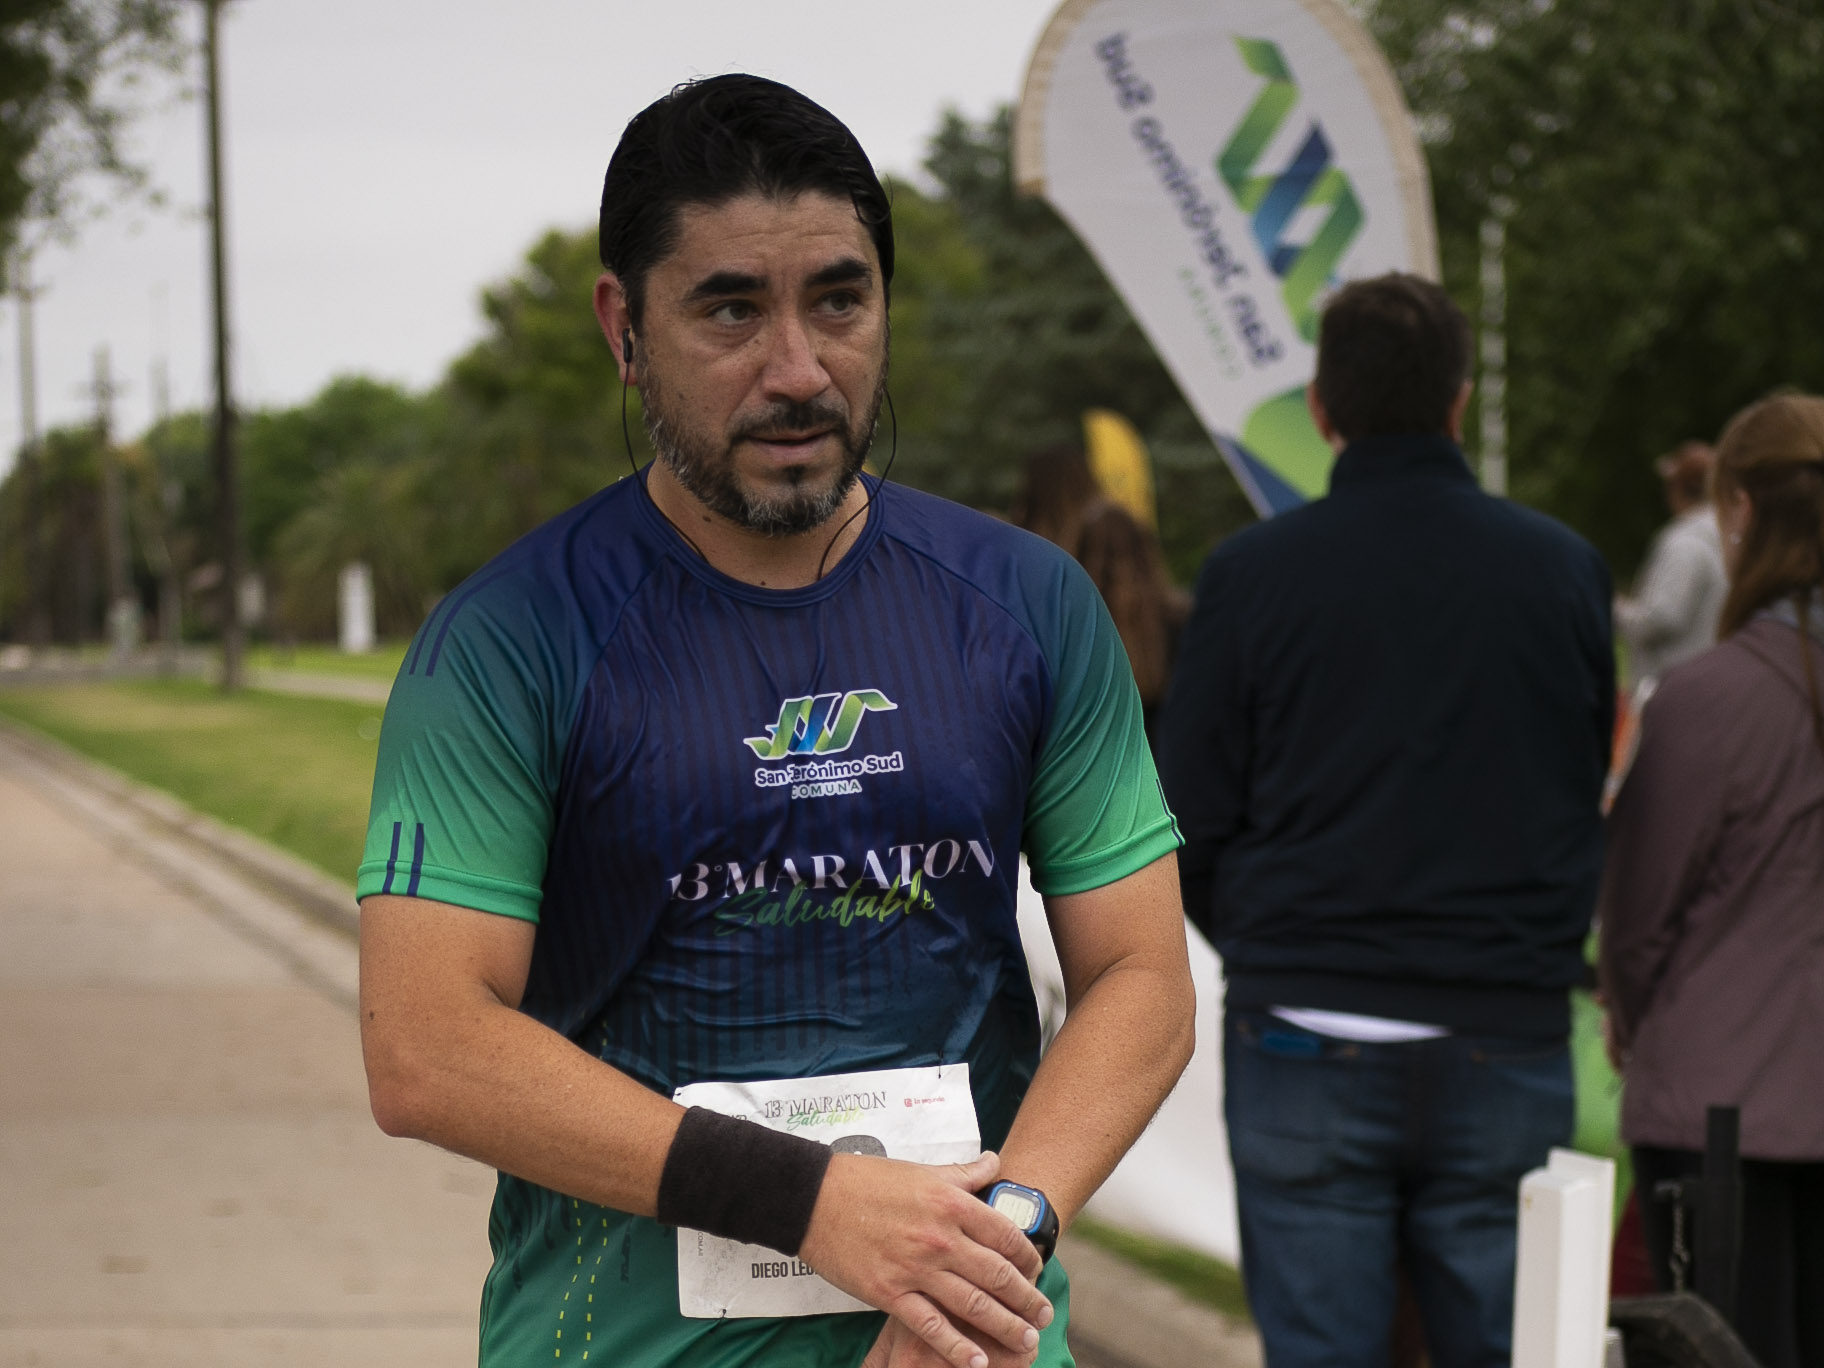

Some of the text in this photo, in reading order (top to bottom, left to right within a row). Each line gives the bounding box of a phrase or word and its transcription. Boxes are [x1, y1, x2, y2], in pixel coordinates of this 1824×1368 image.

[755, 769, 787, 786] San
[866, 754, 902, 773] Sud
[722, 838, 996, 900] MARATON
[713, 869, 936, 937] Saludable
[786, 1105, 865, 1132] Saludable
[789, 1091, 887, 1117] MARATON
[751, 1261, 818, 1279] DIEGO LEO
